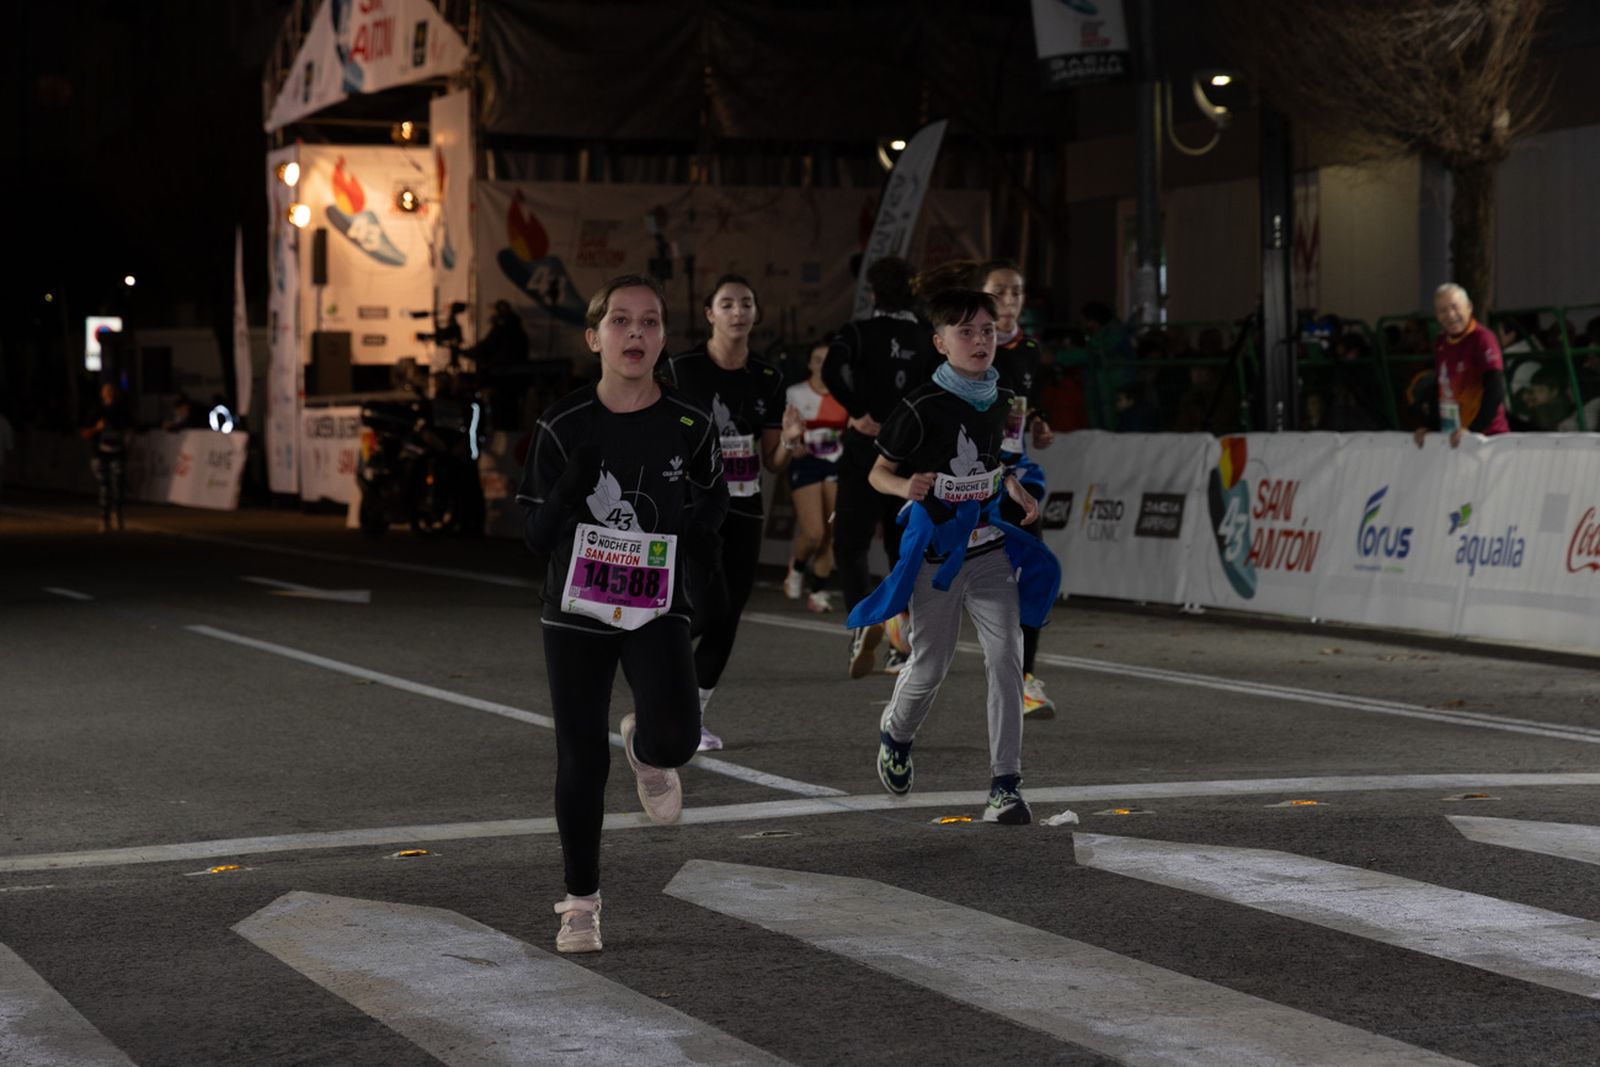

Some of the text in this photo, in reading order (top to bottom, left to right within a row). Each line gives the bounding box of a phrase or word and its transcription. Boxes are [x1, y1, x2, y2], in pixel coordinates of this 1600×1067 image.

[954, 483, 979, 492] NOCHE
[1253, 479, 1300, 520] SAN
[606, 508, 633, 530] 43
[585, 547, 604, 561] SAN
[597, 538, 627, 552] NOCHE
[629, 542, 642, 553] DE
[1244, 516, 1322, 572] ANTÓN
[1455, 525, 1526, 578] aqualia
[583, 562, 660, 598] 14588
